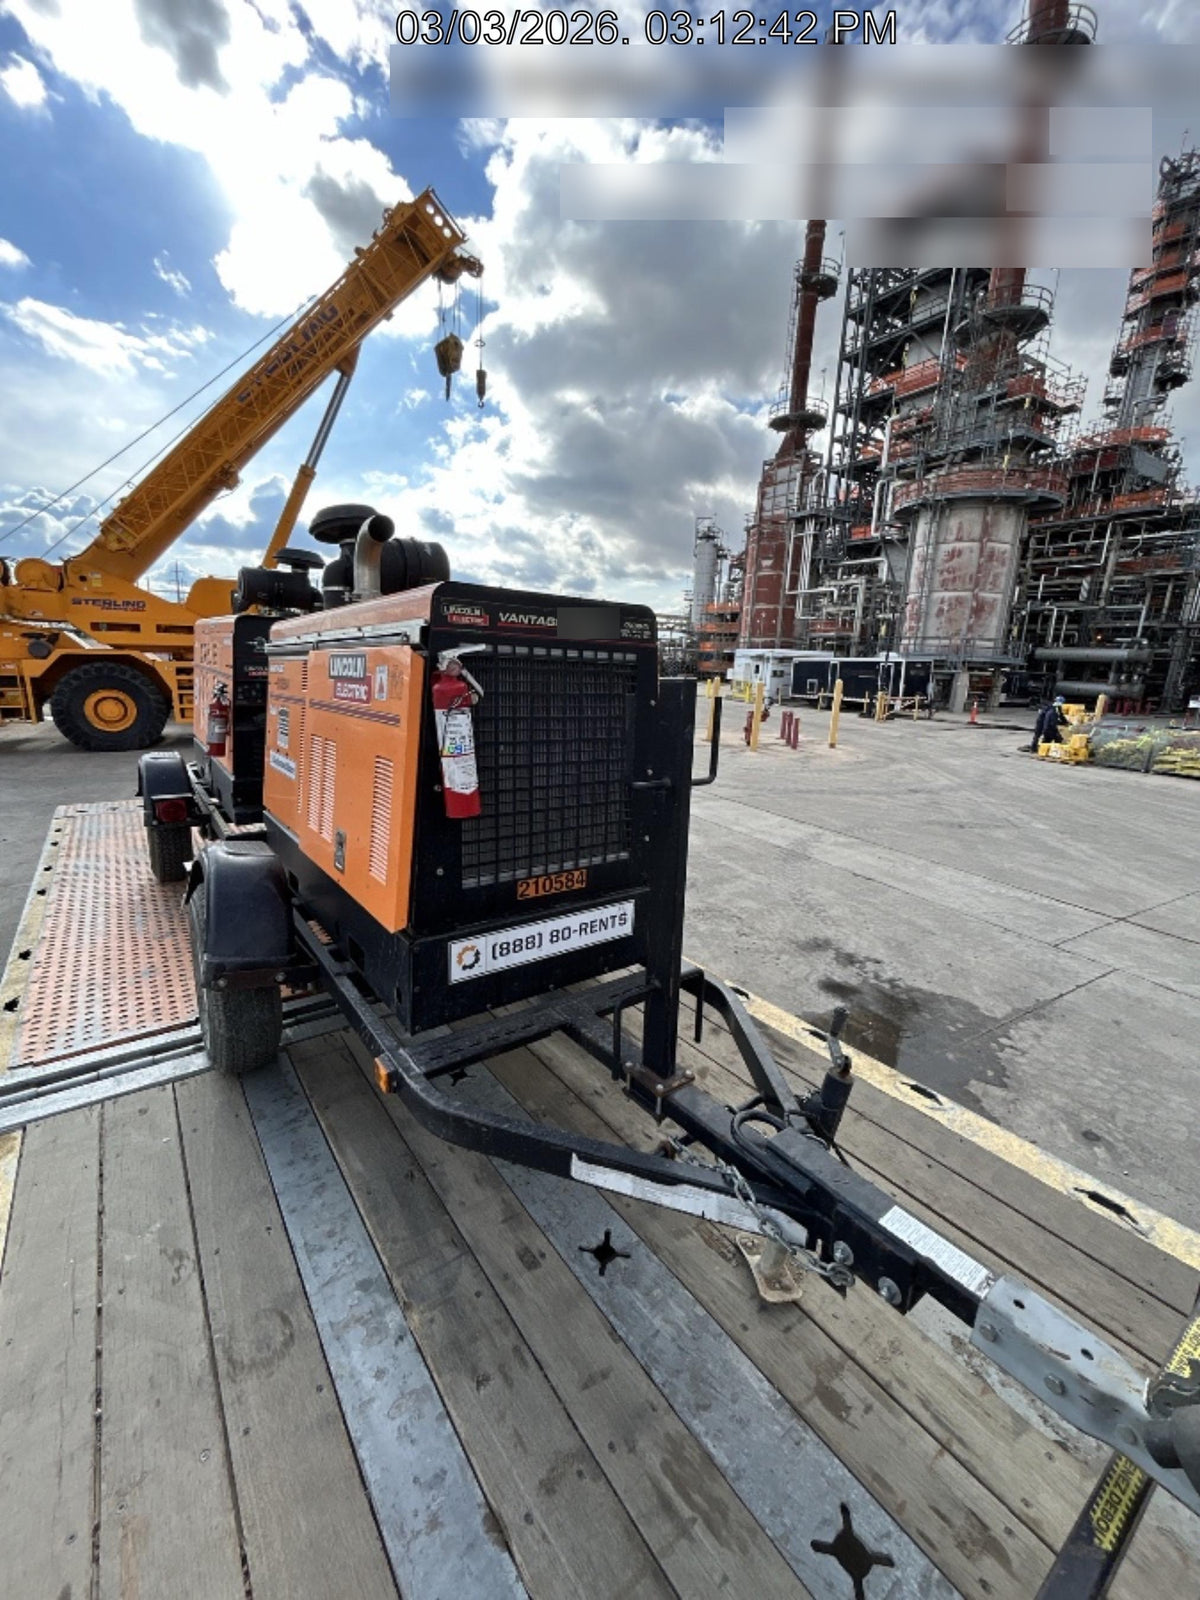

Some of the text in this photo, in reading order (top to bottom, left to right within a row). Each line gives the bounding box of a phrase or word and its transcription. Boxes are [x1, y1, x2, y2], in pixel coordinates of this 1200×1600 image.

[499, 611, 558, 626] VANTAG
[330, 656, 366, 678] LINCOLN
[336, 682, 369, 700] ELECTRIC
[519, 870, 586, 898] 210584
[491, 911, 628, 960] (888) 80-RENTS
